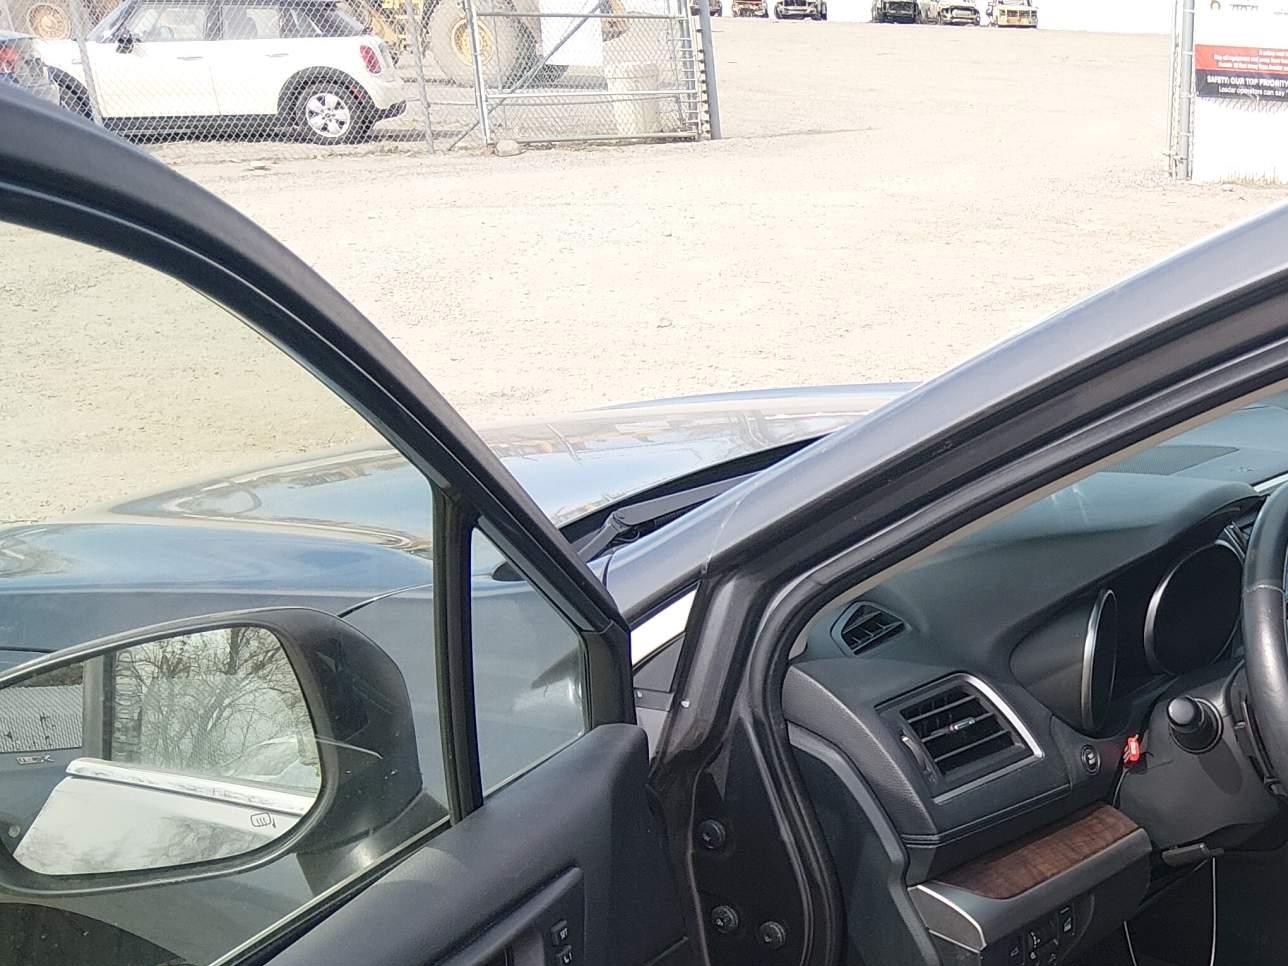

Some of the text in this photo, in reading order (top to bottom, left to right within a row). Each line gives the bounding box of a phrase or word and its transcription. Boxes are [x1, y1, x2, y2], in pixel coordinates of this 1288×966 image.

[1230, 76, 1245, 85] OUR
[1246, 77, 1258, 85] TOP
[1236, 87, 1263, 96] operators
